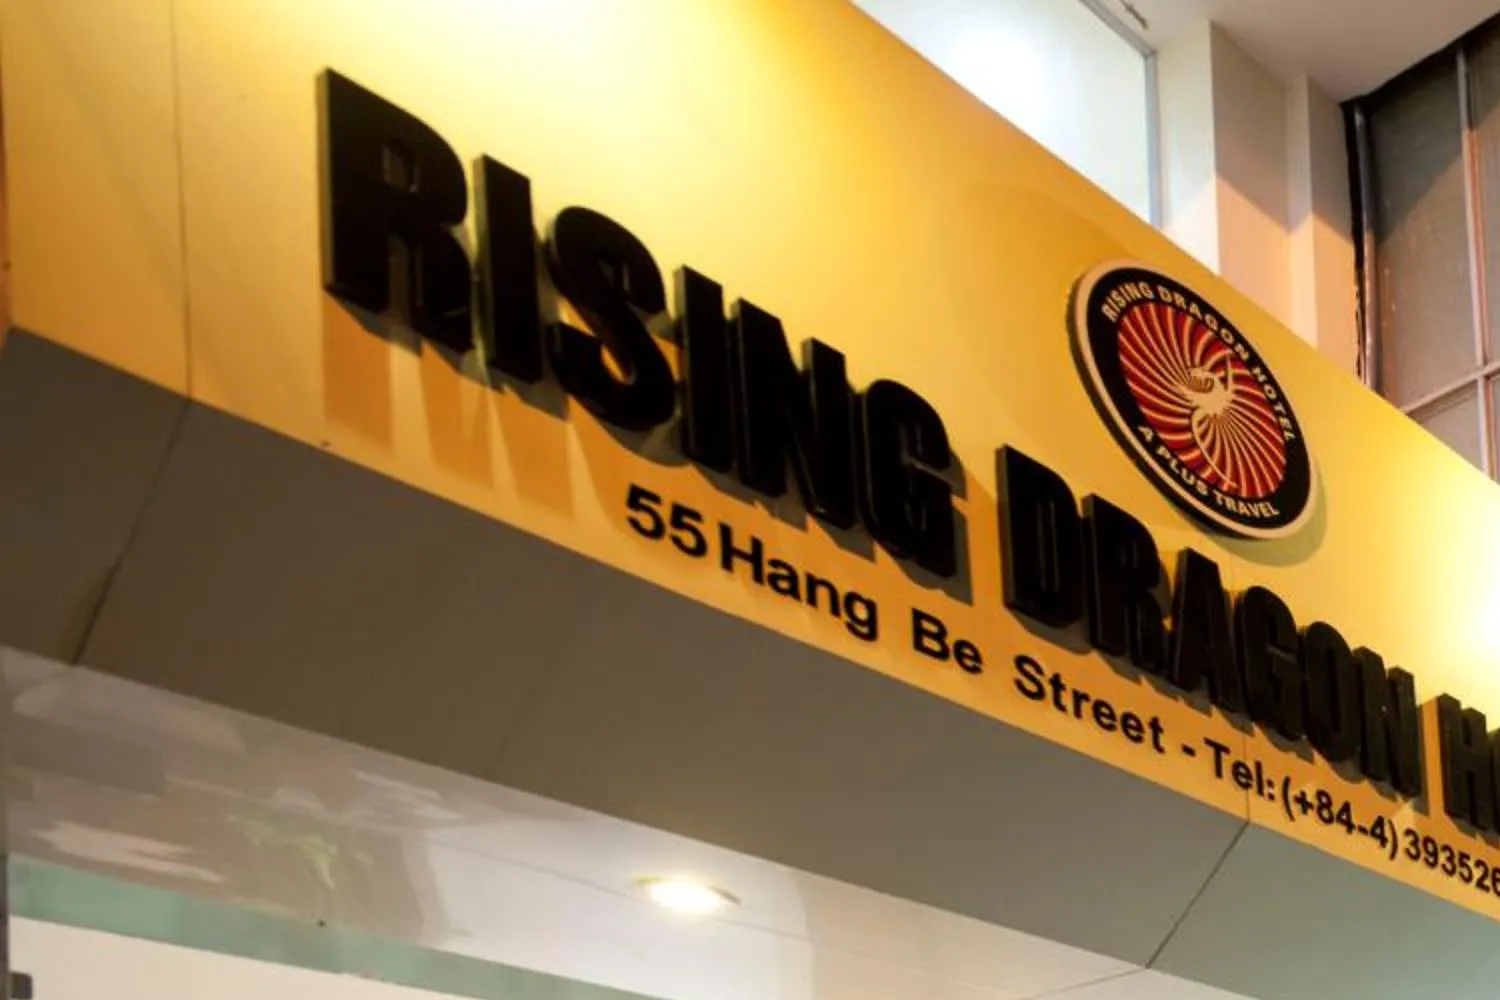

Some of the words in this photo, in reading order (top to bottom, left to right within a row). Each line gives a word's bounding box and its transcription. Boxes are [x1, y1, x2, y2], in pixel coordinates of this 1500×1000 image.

[316, 66, 964, 592] RISING
[996, 445, 1422, 802] DRAGON
[1102, 281, 1155, 323] RISING
[1156, 284, 1249, 361] DRAGON
[1251, 365, 1296, 441] HOTEL
[1138, 424, 1154, 441] A
[1155, 445, 1210, 497] PLUS
[1214, 491, 1281, 518] TRAVEL
[625, 483, 708, 558] 55
[718, 521, 878, 642] Hang
[911, 608, 983, 675] Be
[1013, 655, 1166, 754] Street
